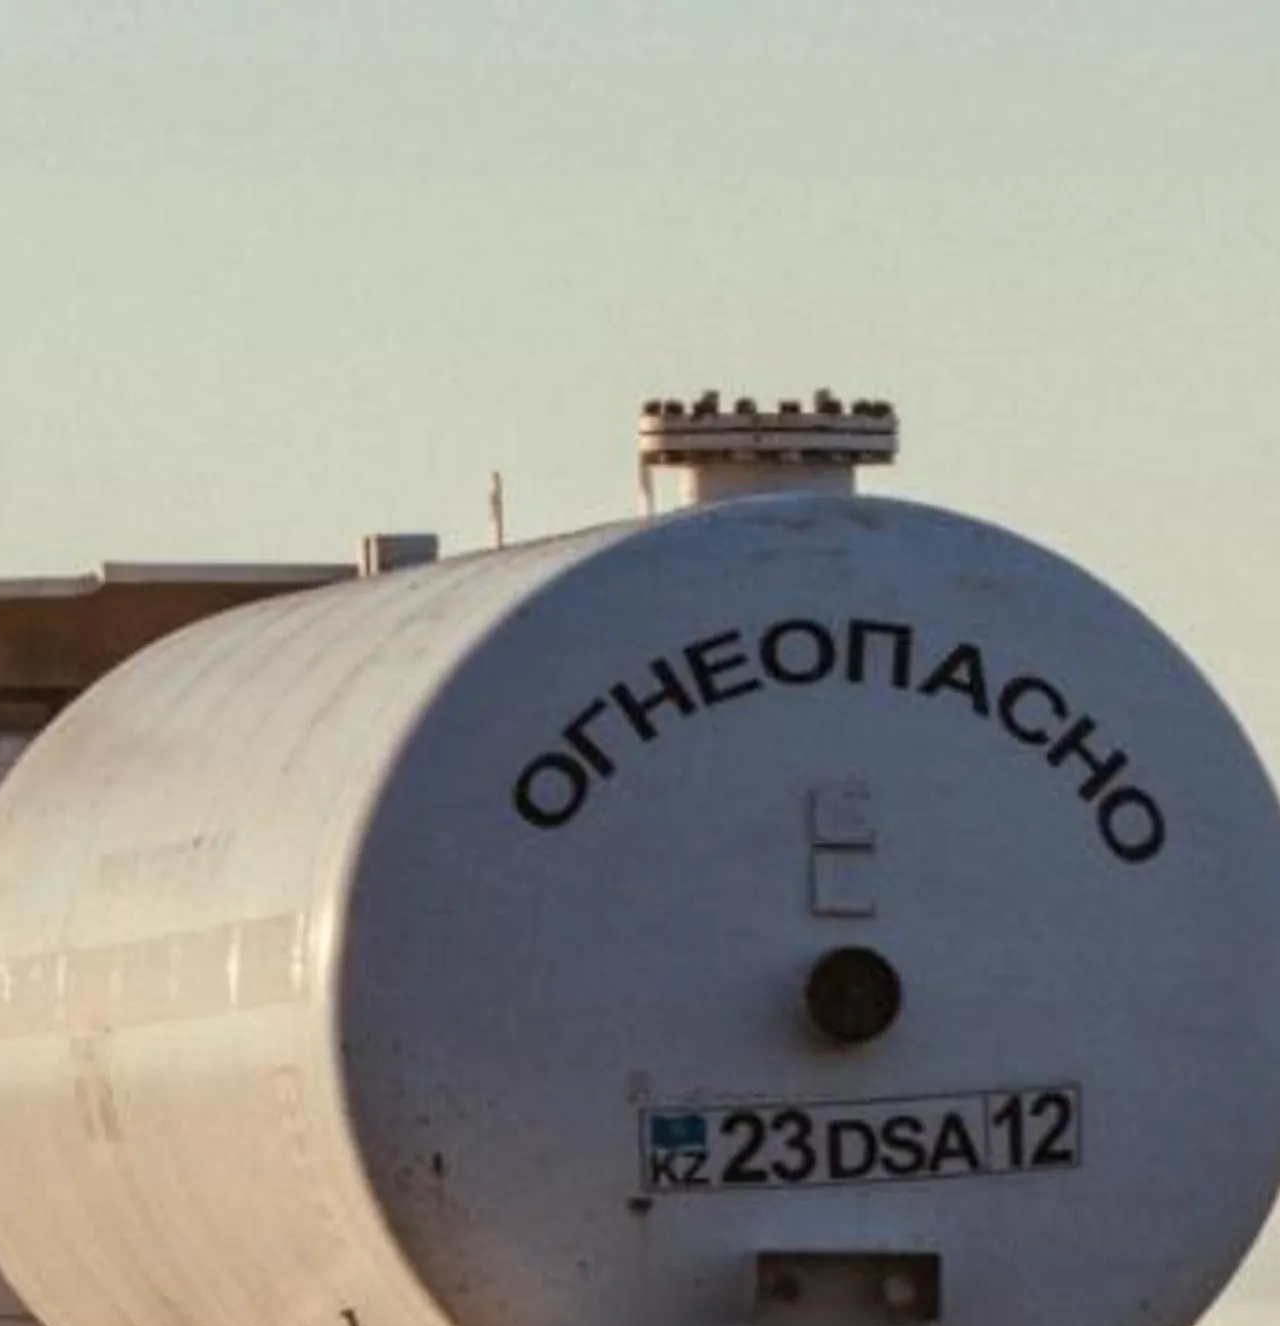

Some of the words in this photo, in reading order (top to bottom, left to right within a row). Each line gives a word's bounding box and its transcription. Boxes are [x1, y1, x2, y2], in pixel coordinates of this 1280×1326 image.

[511, 618, 1166, 863] ОГНЕОПАСНО
[649, 1151, 710, 1185] KZ
[721, 1110, 817, 1183] 23
[828, 1113, 980, 1179] DSA
[993, 1092, 1075, 1166] 12
